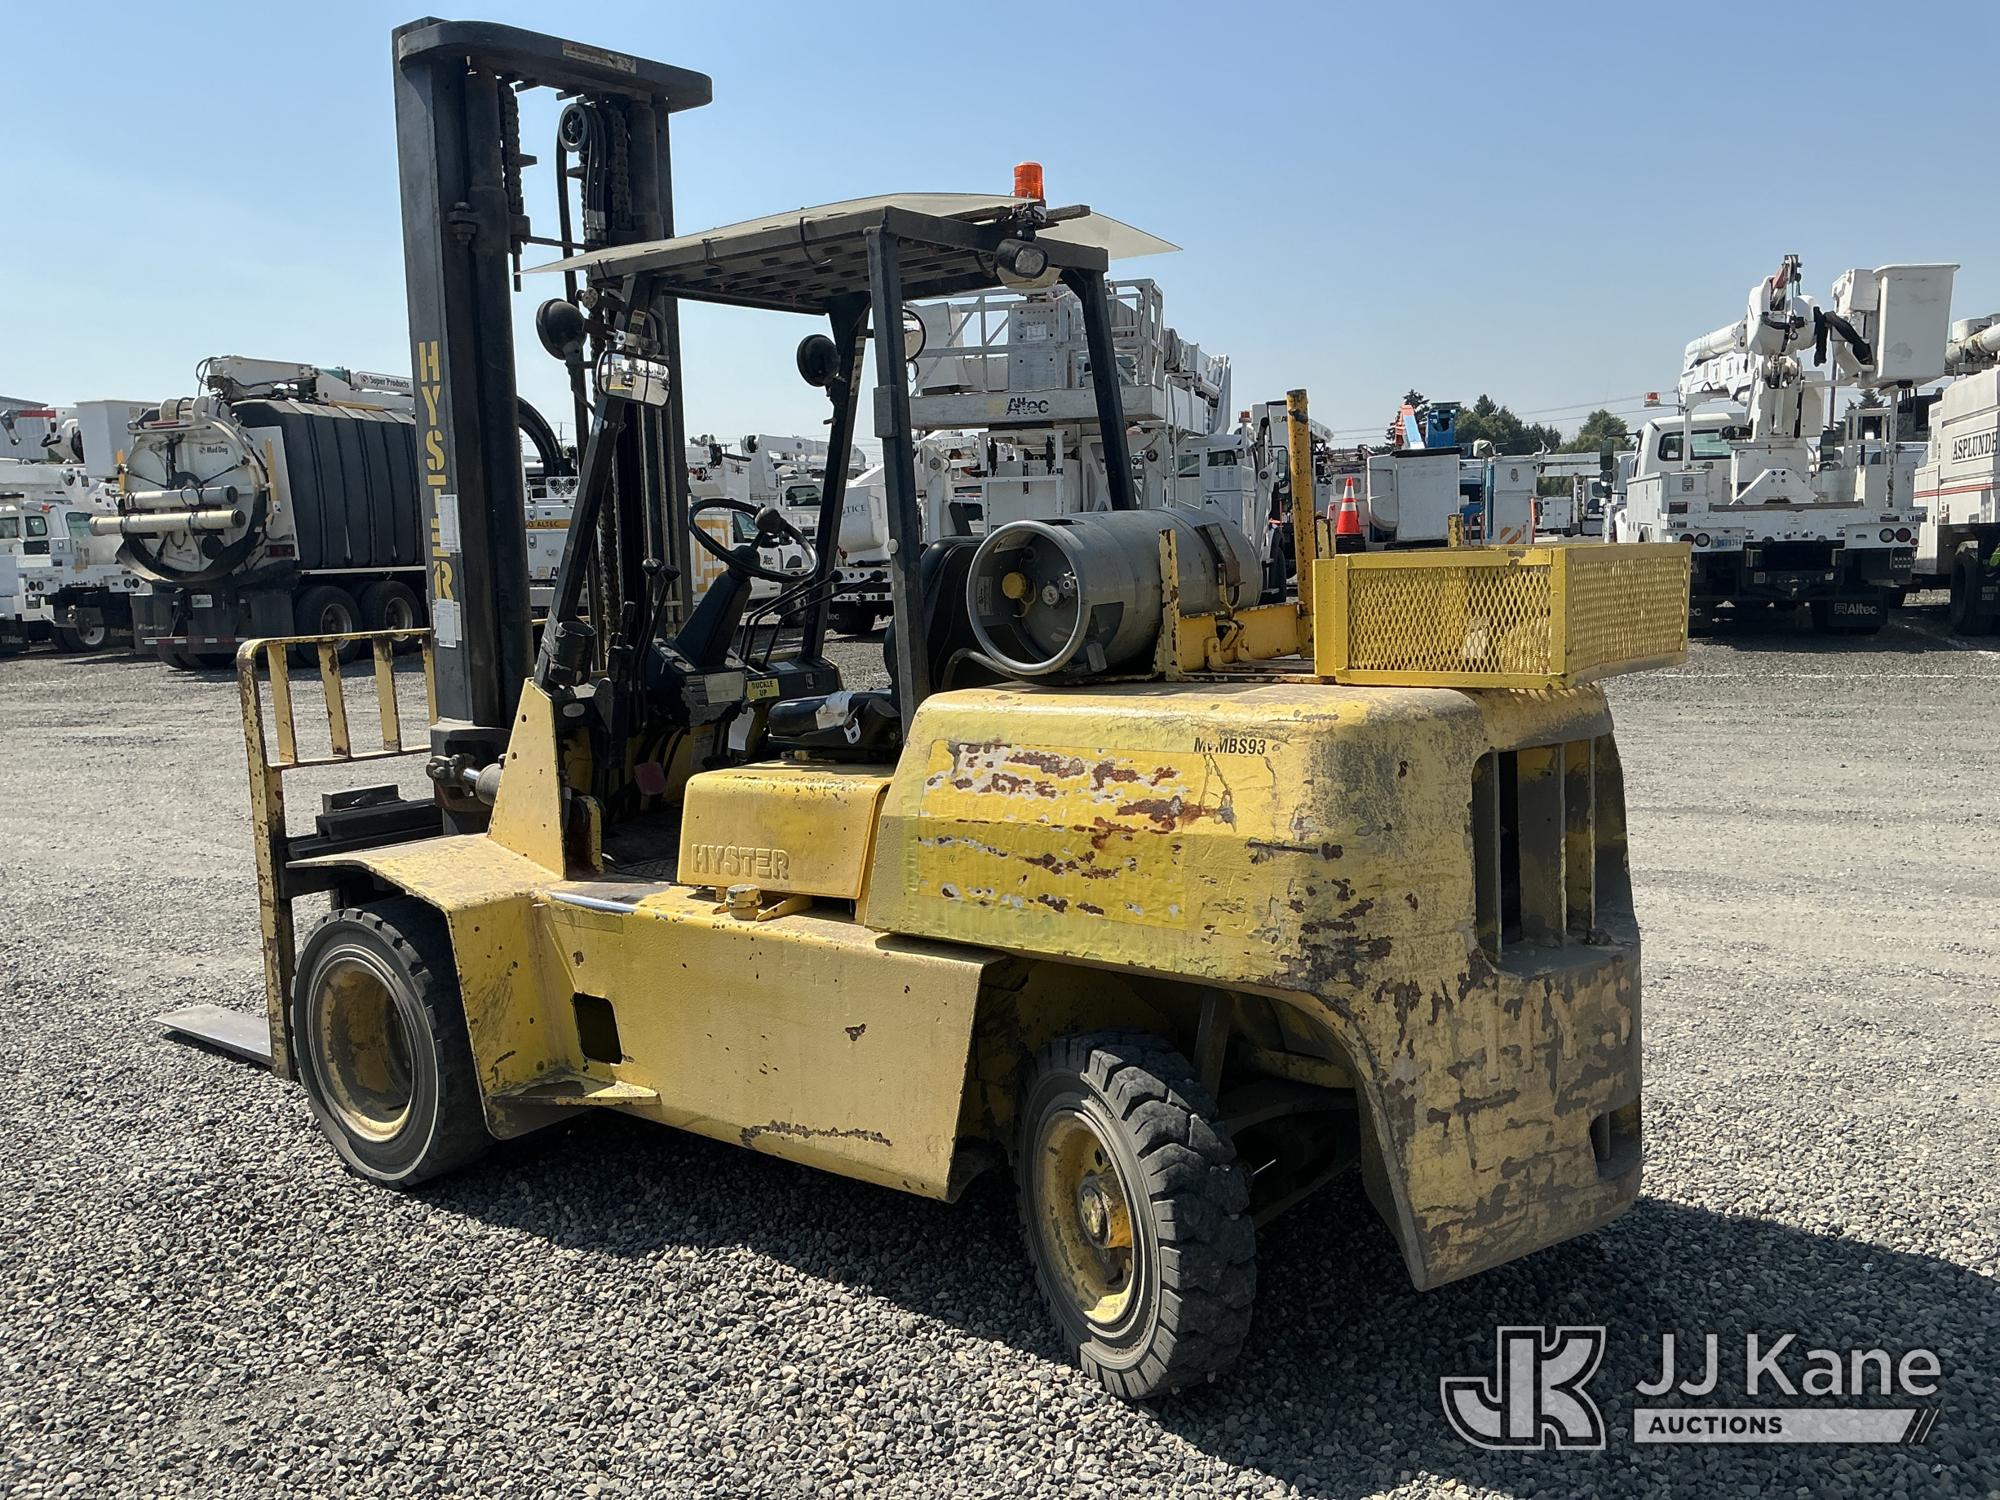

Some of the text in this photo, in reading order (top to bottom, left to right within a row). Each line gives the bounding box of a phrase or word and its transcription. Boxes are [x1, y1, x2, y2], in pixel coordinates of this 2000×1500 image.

[369, 375, 410, 388] Super Products
[1006, 397, 1049, 415] Altec
[1953, 431, 1998, 460] ASPLUNDH
[1847, 603, 1878, 615] Altec
[759, 689, 768, 697] UP
[1193, 736, 1266, 755] MMBS93
[691, 843, 790, 880] HYSTER
